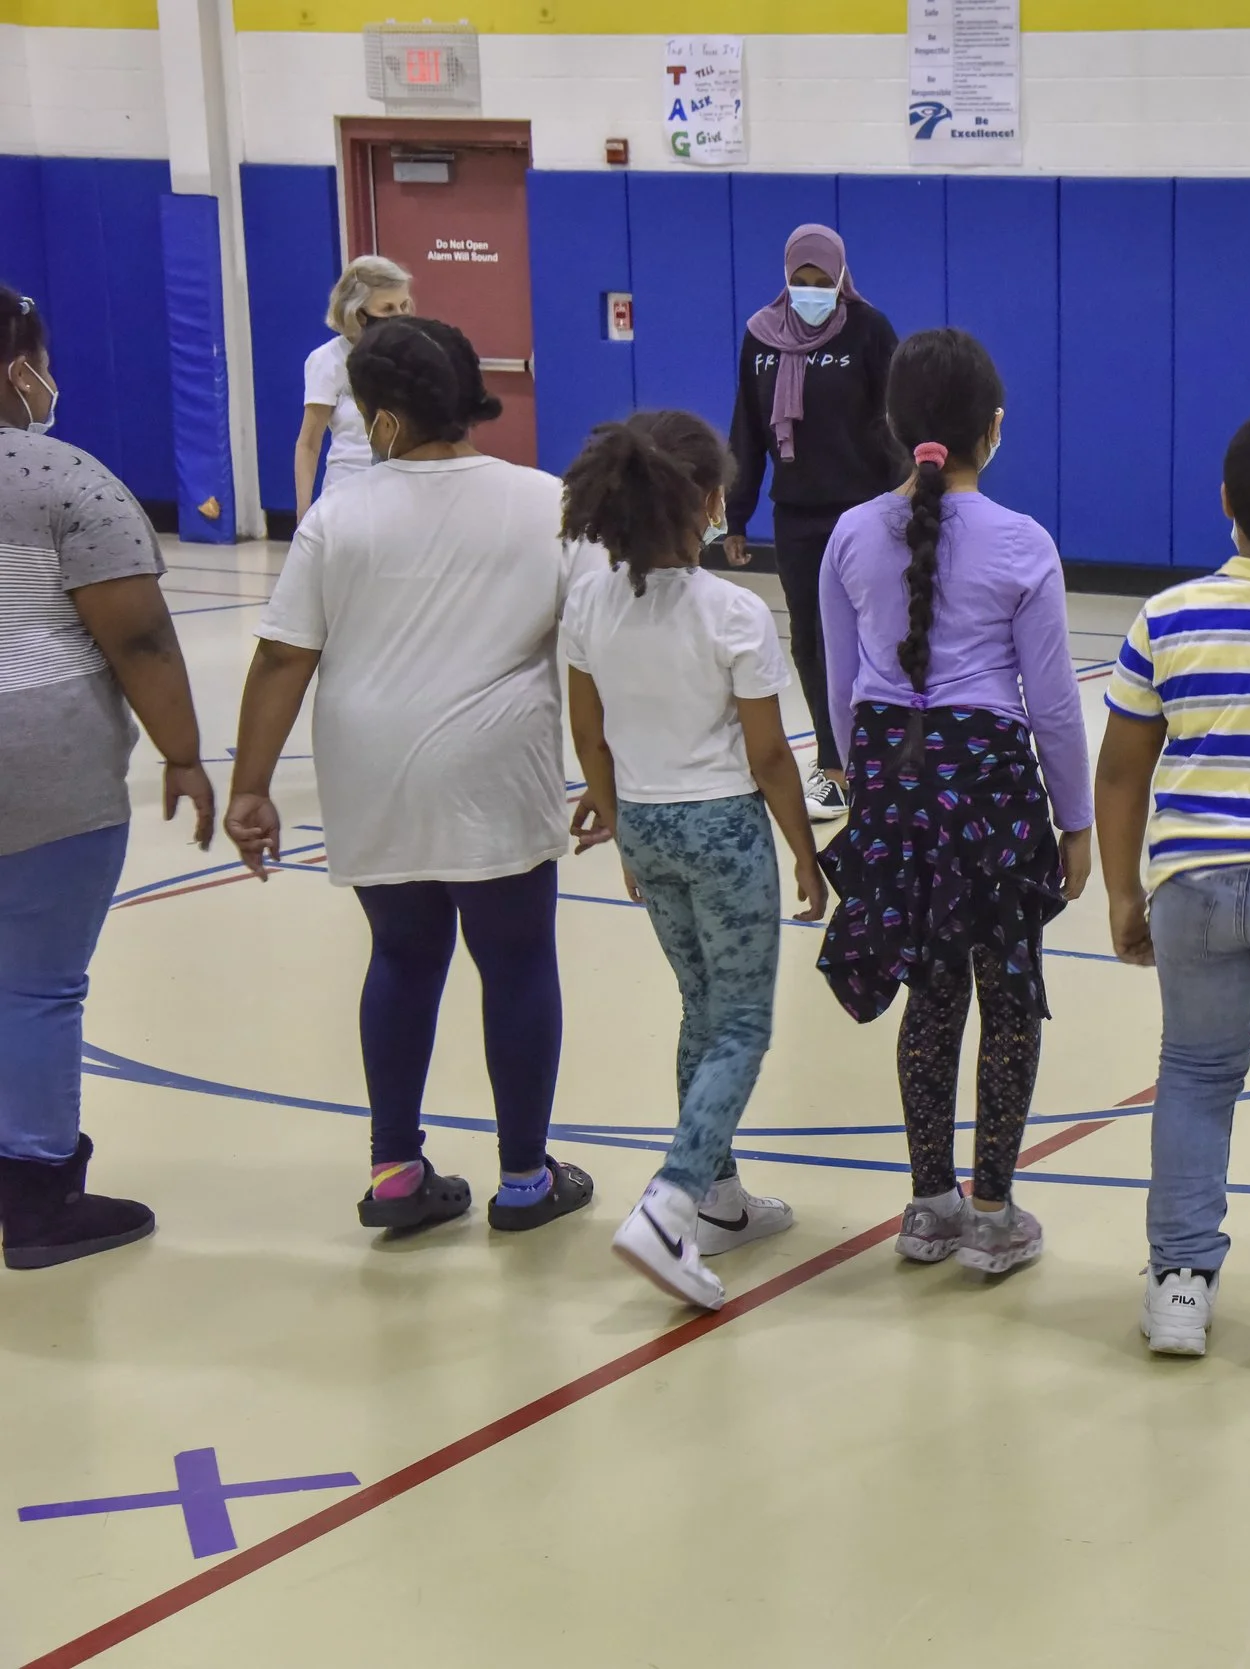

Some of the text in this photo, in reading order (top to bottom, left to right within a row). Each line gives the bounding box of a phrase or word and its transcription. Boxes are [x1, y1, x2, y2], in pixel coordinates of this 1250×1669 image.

[406, 49, 441, 85] EXIT
[666, 65, 687, 85] T
[668, 98, 688, 121] A
[975, 116, 989, 125] Be
[950, 129, 1014, 139] Excellence!
[671, 130, 691, 157] G
[435, 239, 489, 251] Do Not Open
[427, 250, 498, 263] Alarm Will Sound
[1171, 1294, 1196, 1306] FILA
